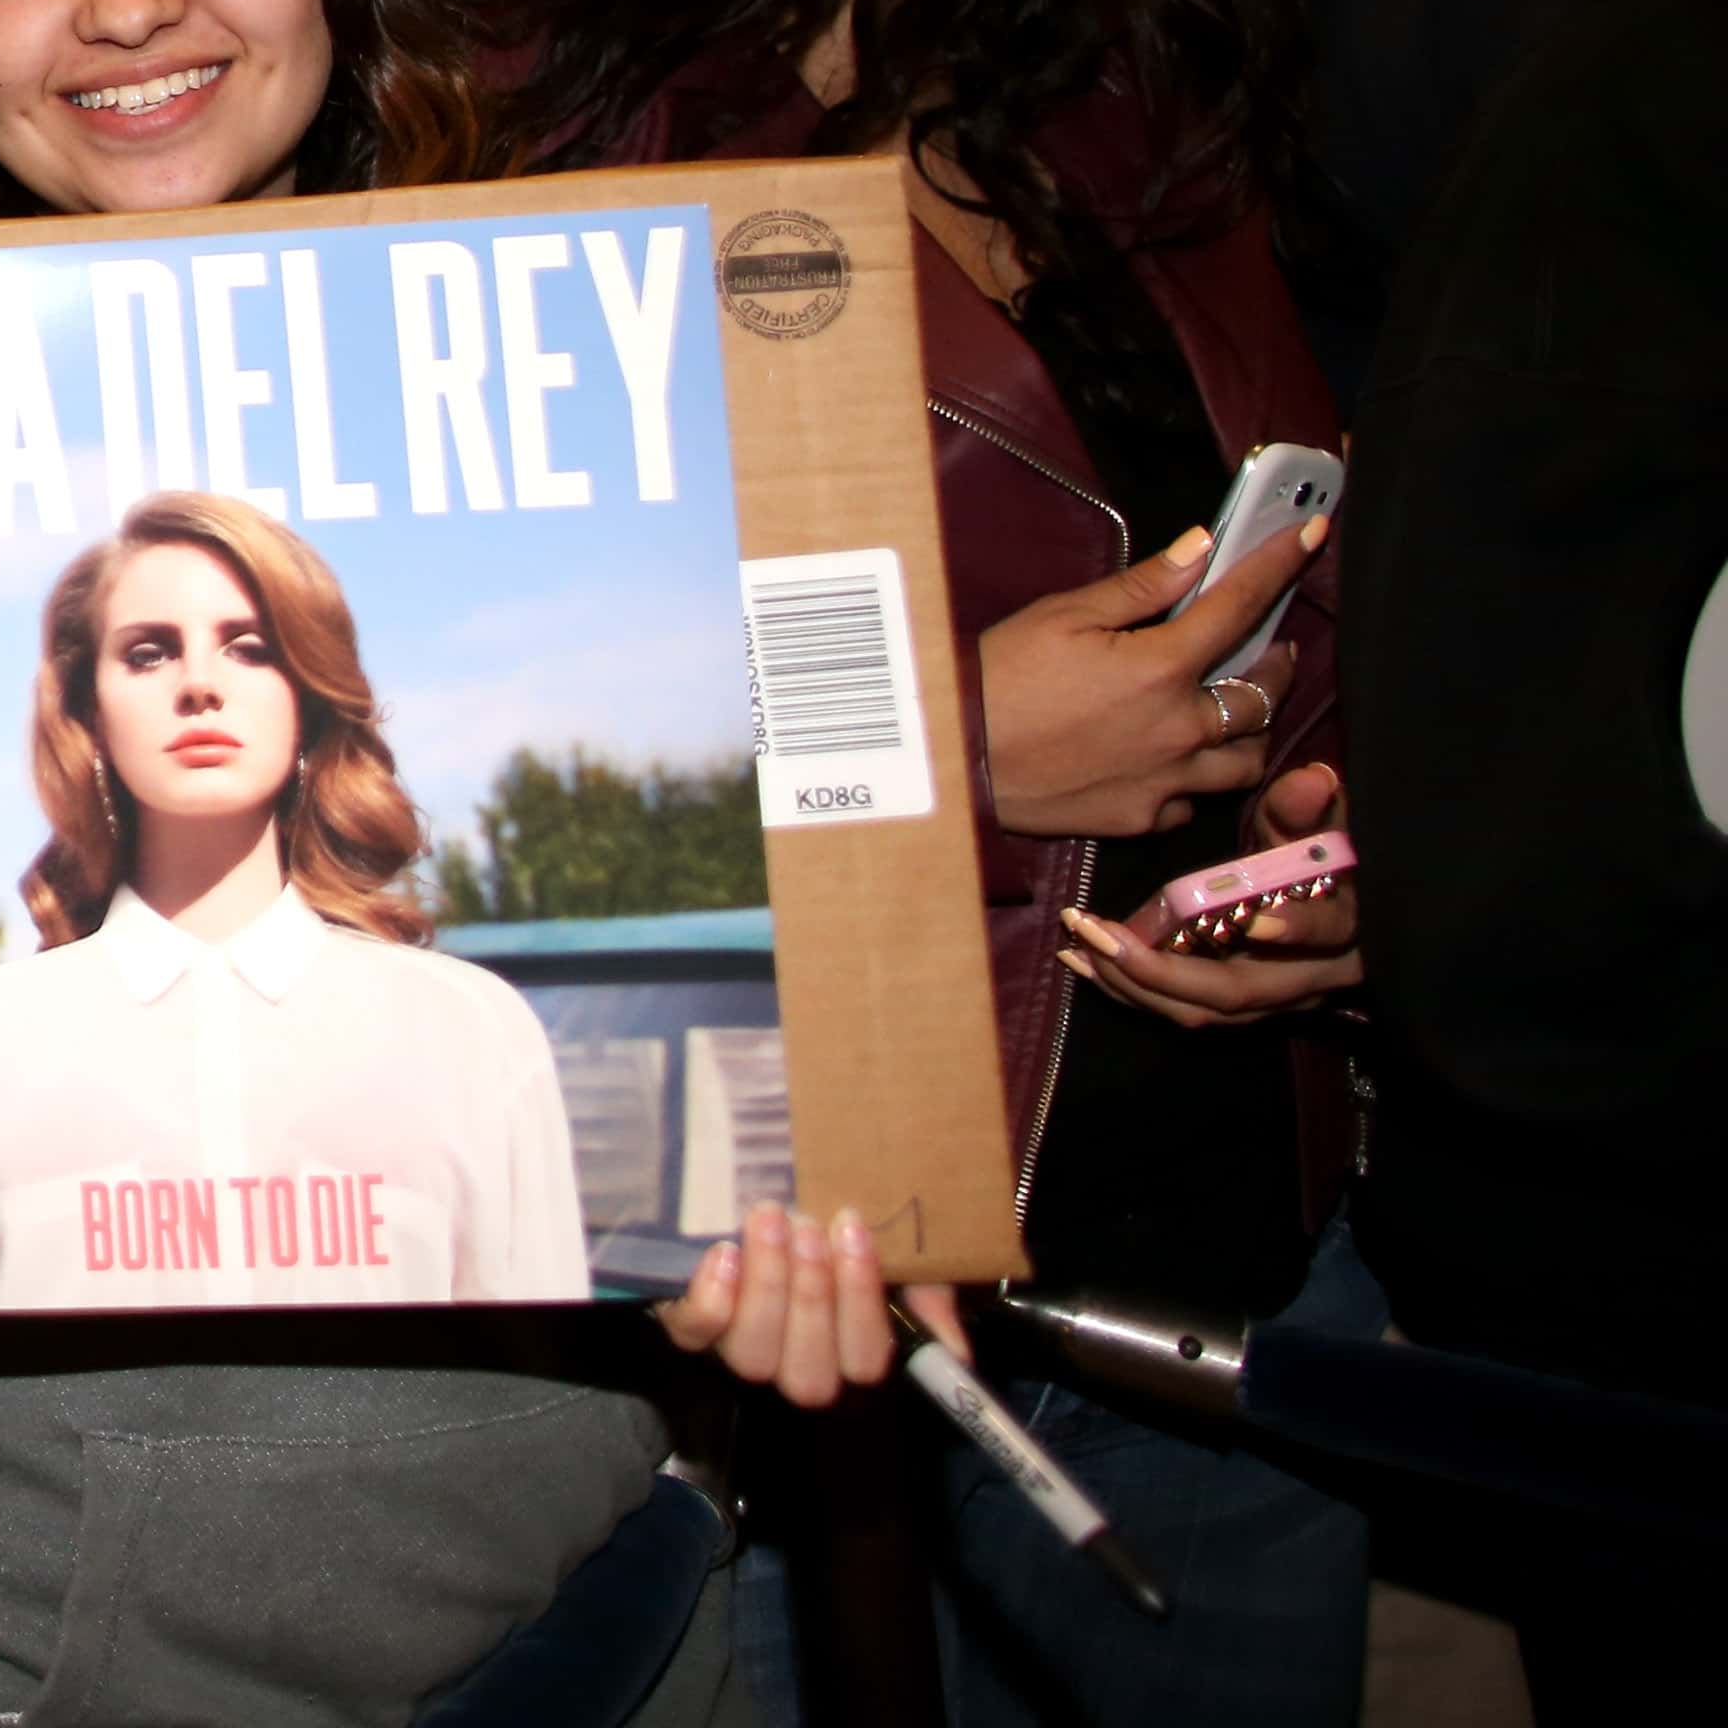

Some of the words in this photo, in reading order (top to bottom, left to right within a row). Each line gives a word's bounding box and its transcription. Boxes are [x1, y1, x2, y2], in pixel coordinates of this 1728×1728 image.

[737, 223, 820, 251] PACKAGING
[740, 292, 830, 327] CERTIFIED
[90, 249, 377, 524] DEL
[390, 226, 684, 514] REY
[796, 784, 873, 811] KD8G
[80, 1178, 220, 1271] BORN
[229, 1176, 299, 1268] TO
[308, 1174, 389, 1267] DIE
